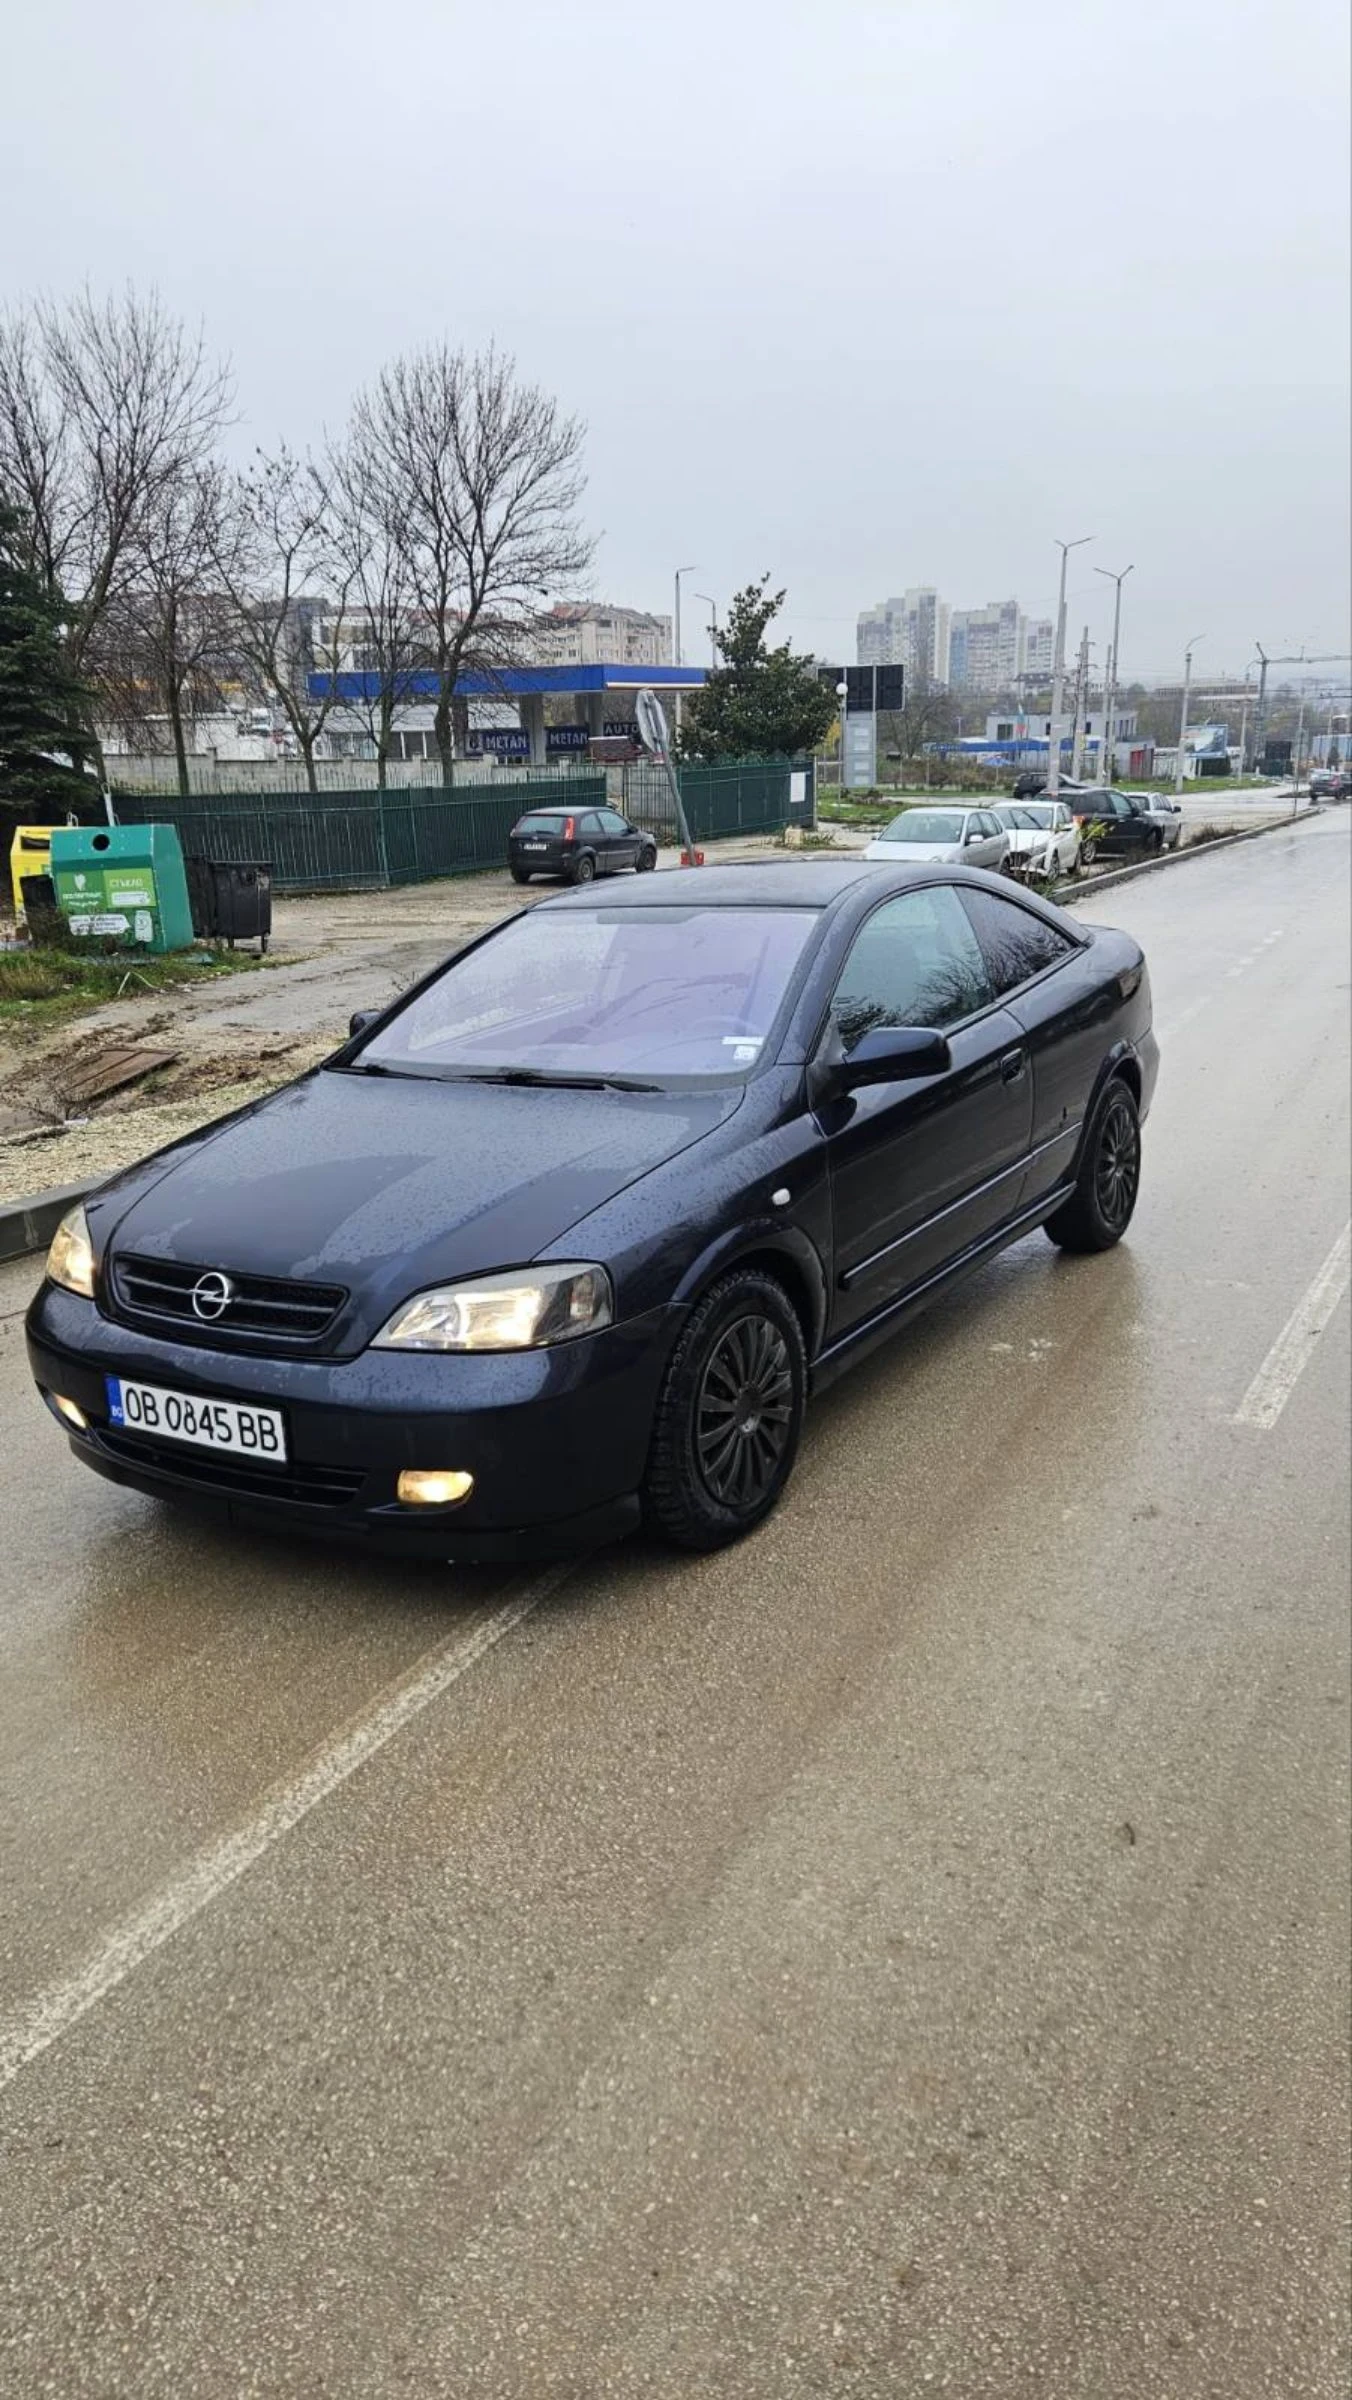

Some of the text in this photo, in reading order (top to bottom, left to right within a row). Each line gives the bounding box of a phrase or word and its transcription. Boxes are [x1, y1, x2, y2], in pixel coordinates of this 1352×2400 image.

[485, 735, 527, 749] METAN
[550, 732, 589, 745] METAN
[125, 1388, 279, 1451] OB 0845 BB
